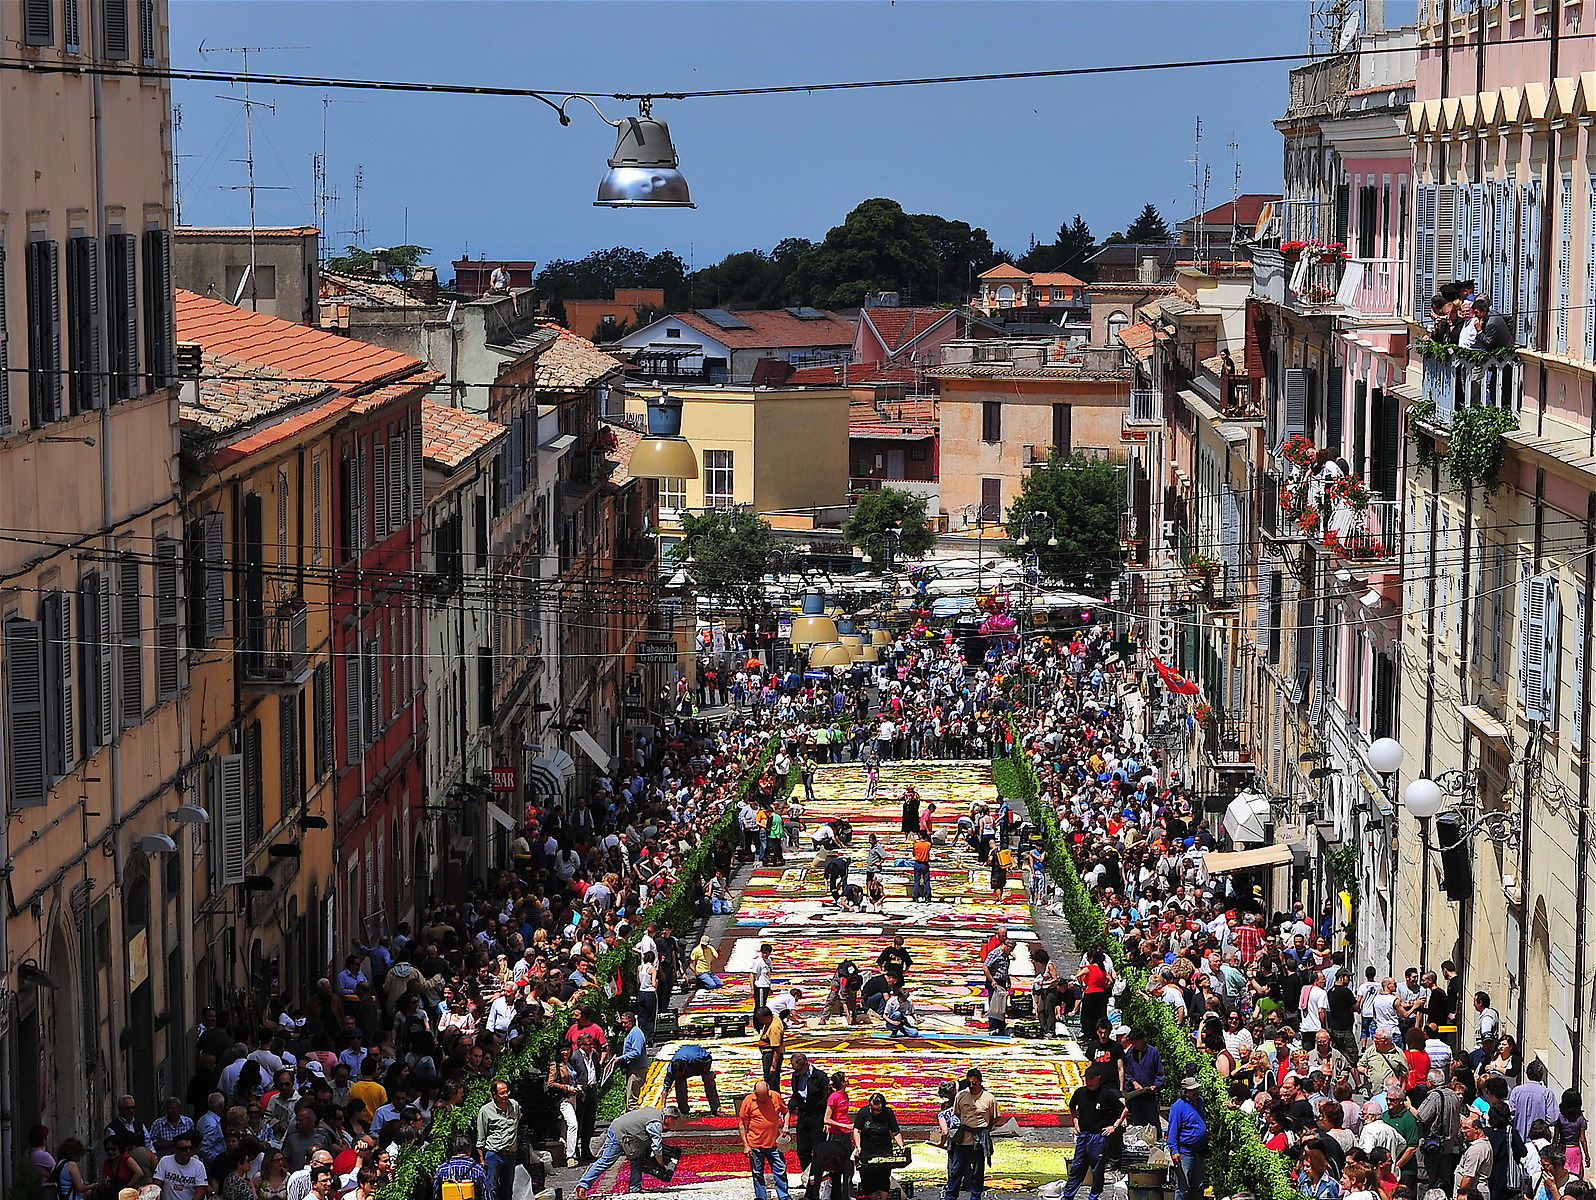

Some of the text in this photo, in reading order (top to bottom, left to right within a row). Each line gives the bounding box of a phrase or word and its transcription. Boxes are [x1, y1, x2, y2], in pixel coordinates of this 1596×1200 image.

[640, 643, 676, 653] Tabacchi
[640, 653, 675, 662] Giornali
[494, 772, 514, 787] BAR
